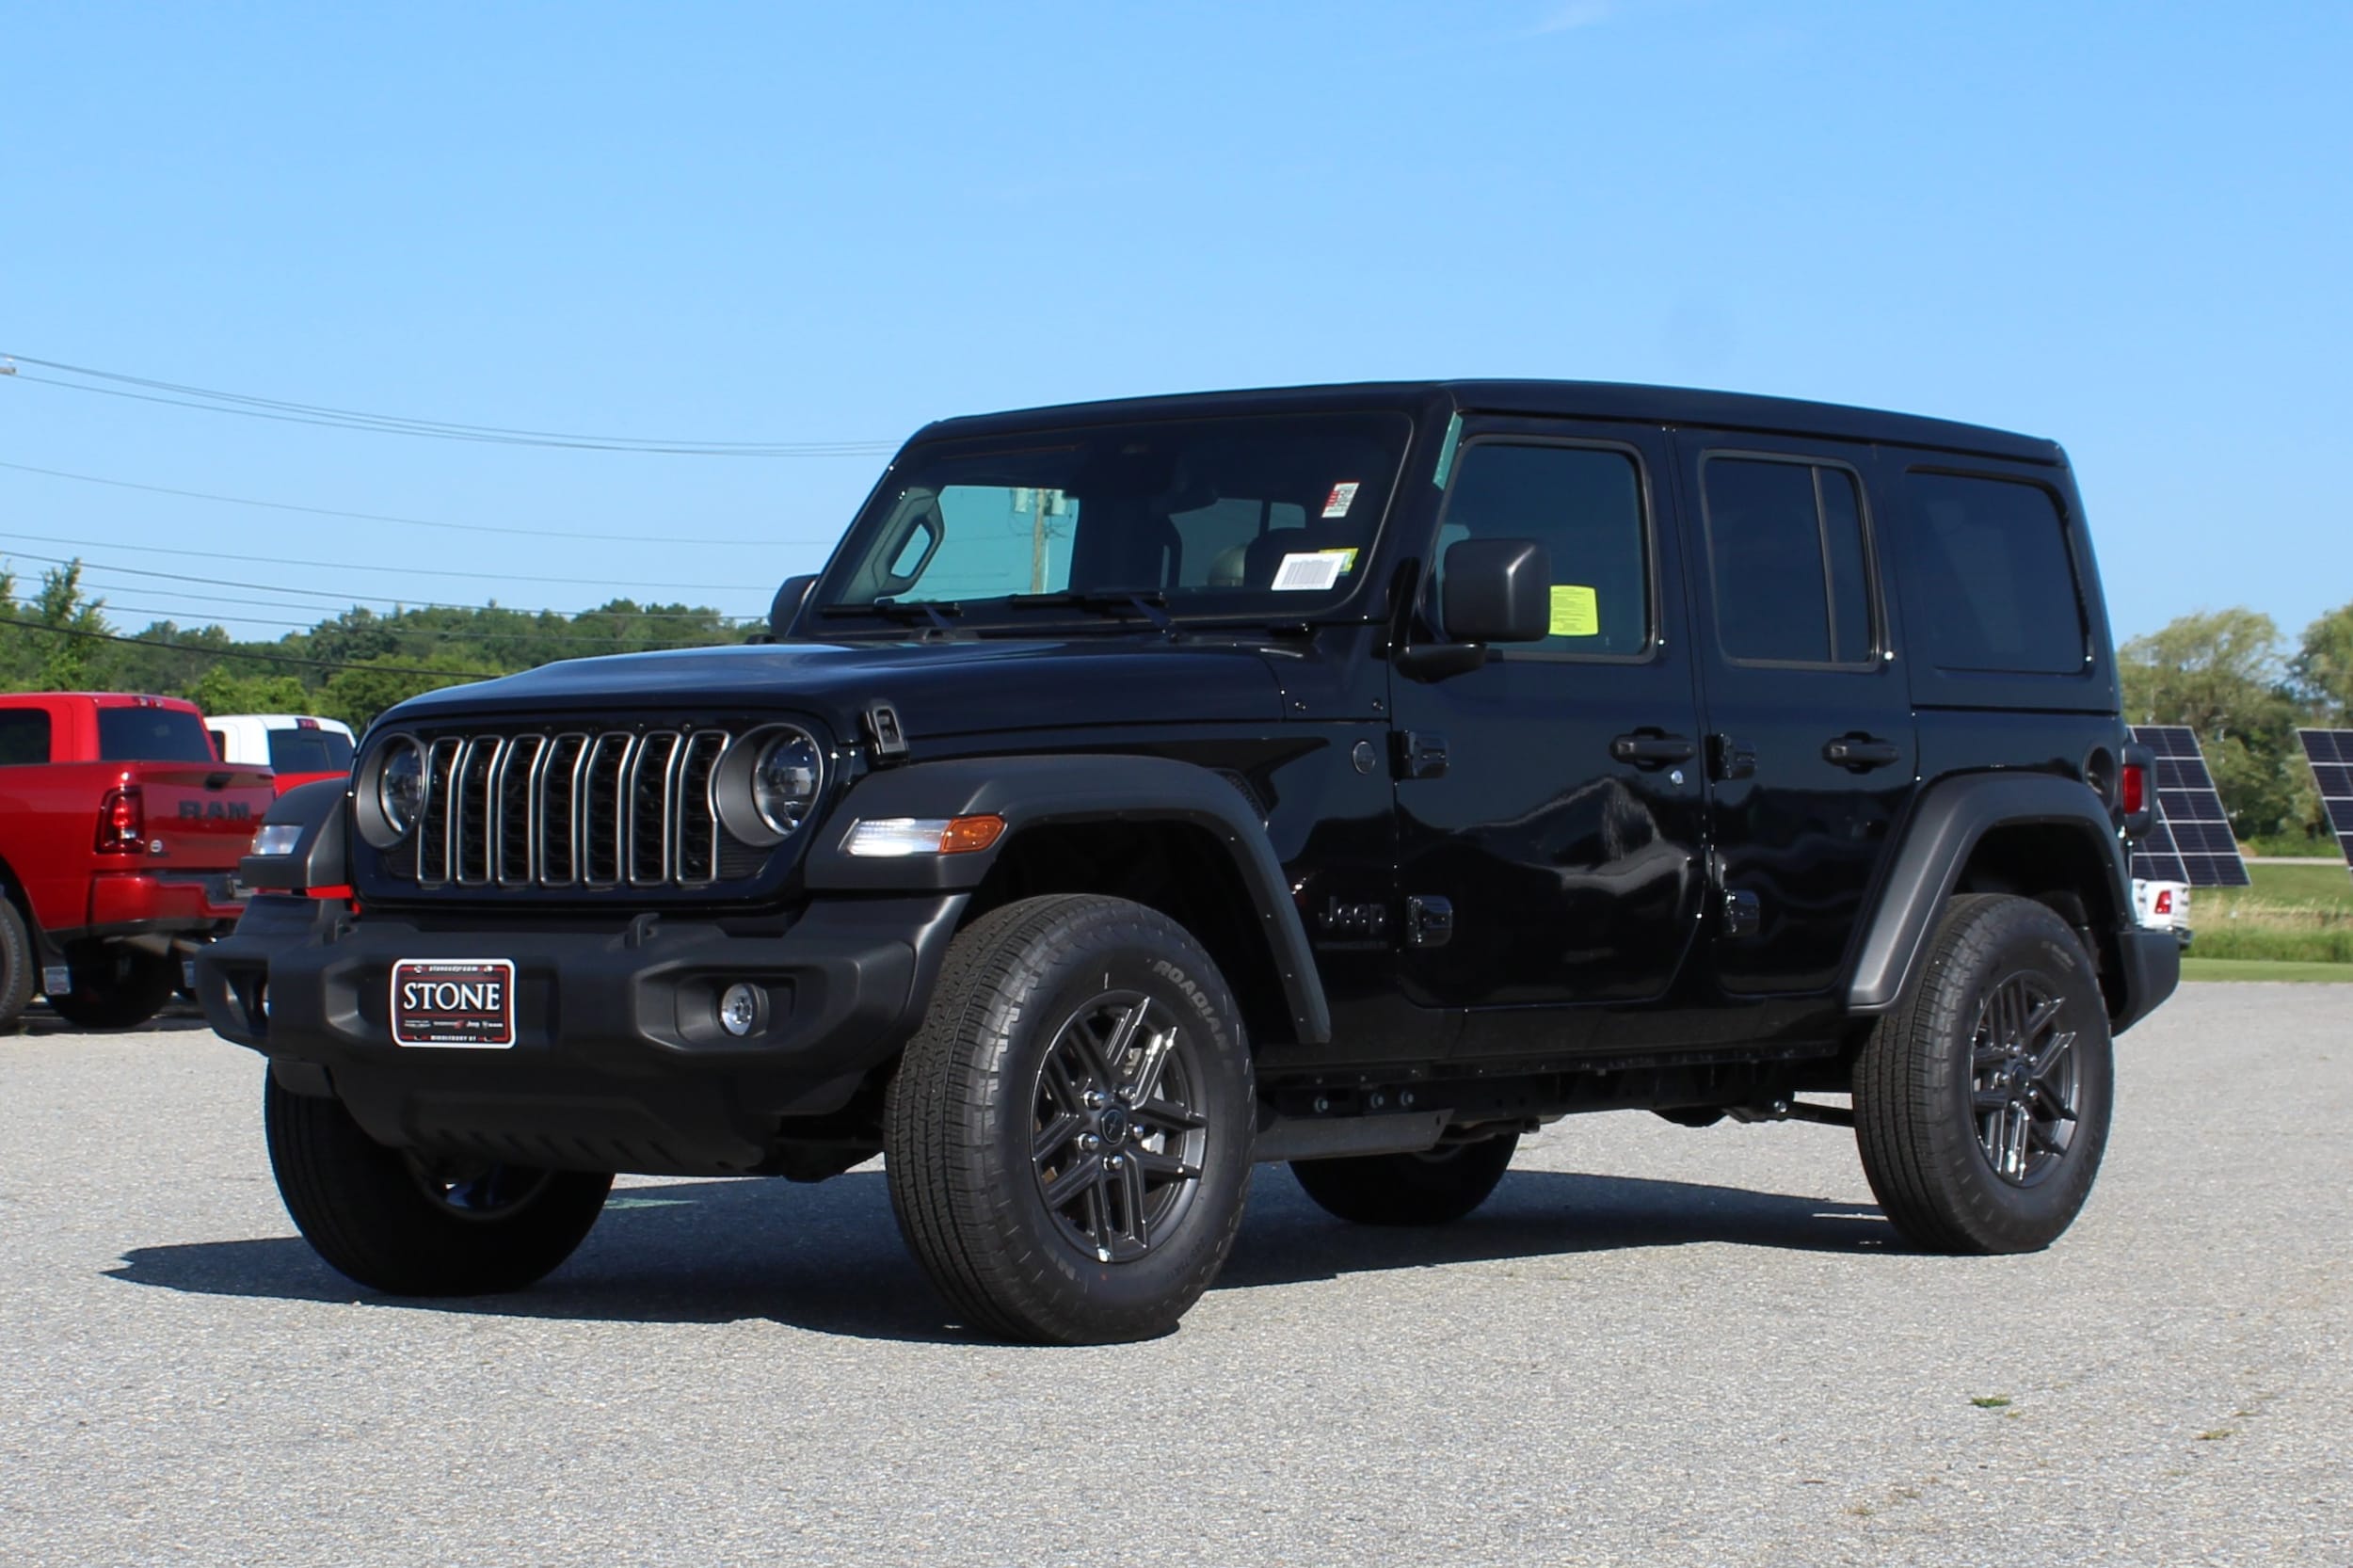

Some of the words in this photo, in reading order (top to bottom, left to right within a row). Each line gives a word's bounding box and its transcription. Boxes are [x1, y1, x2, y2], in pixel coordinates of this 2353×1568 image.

[179, 800, 250, 820] RAM
[1318, 895, 1385, 934] Jeep
[403, 982, 501, 1011] STONE
